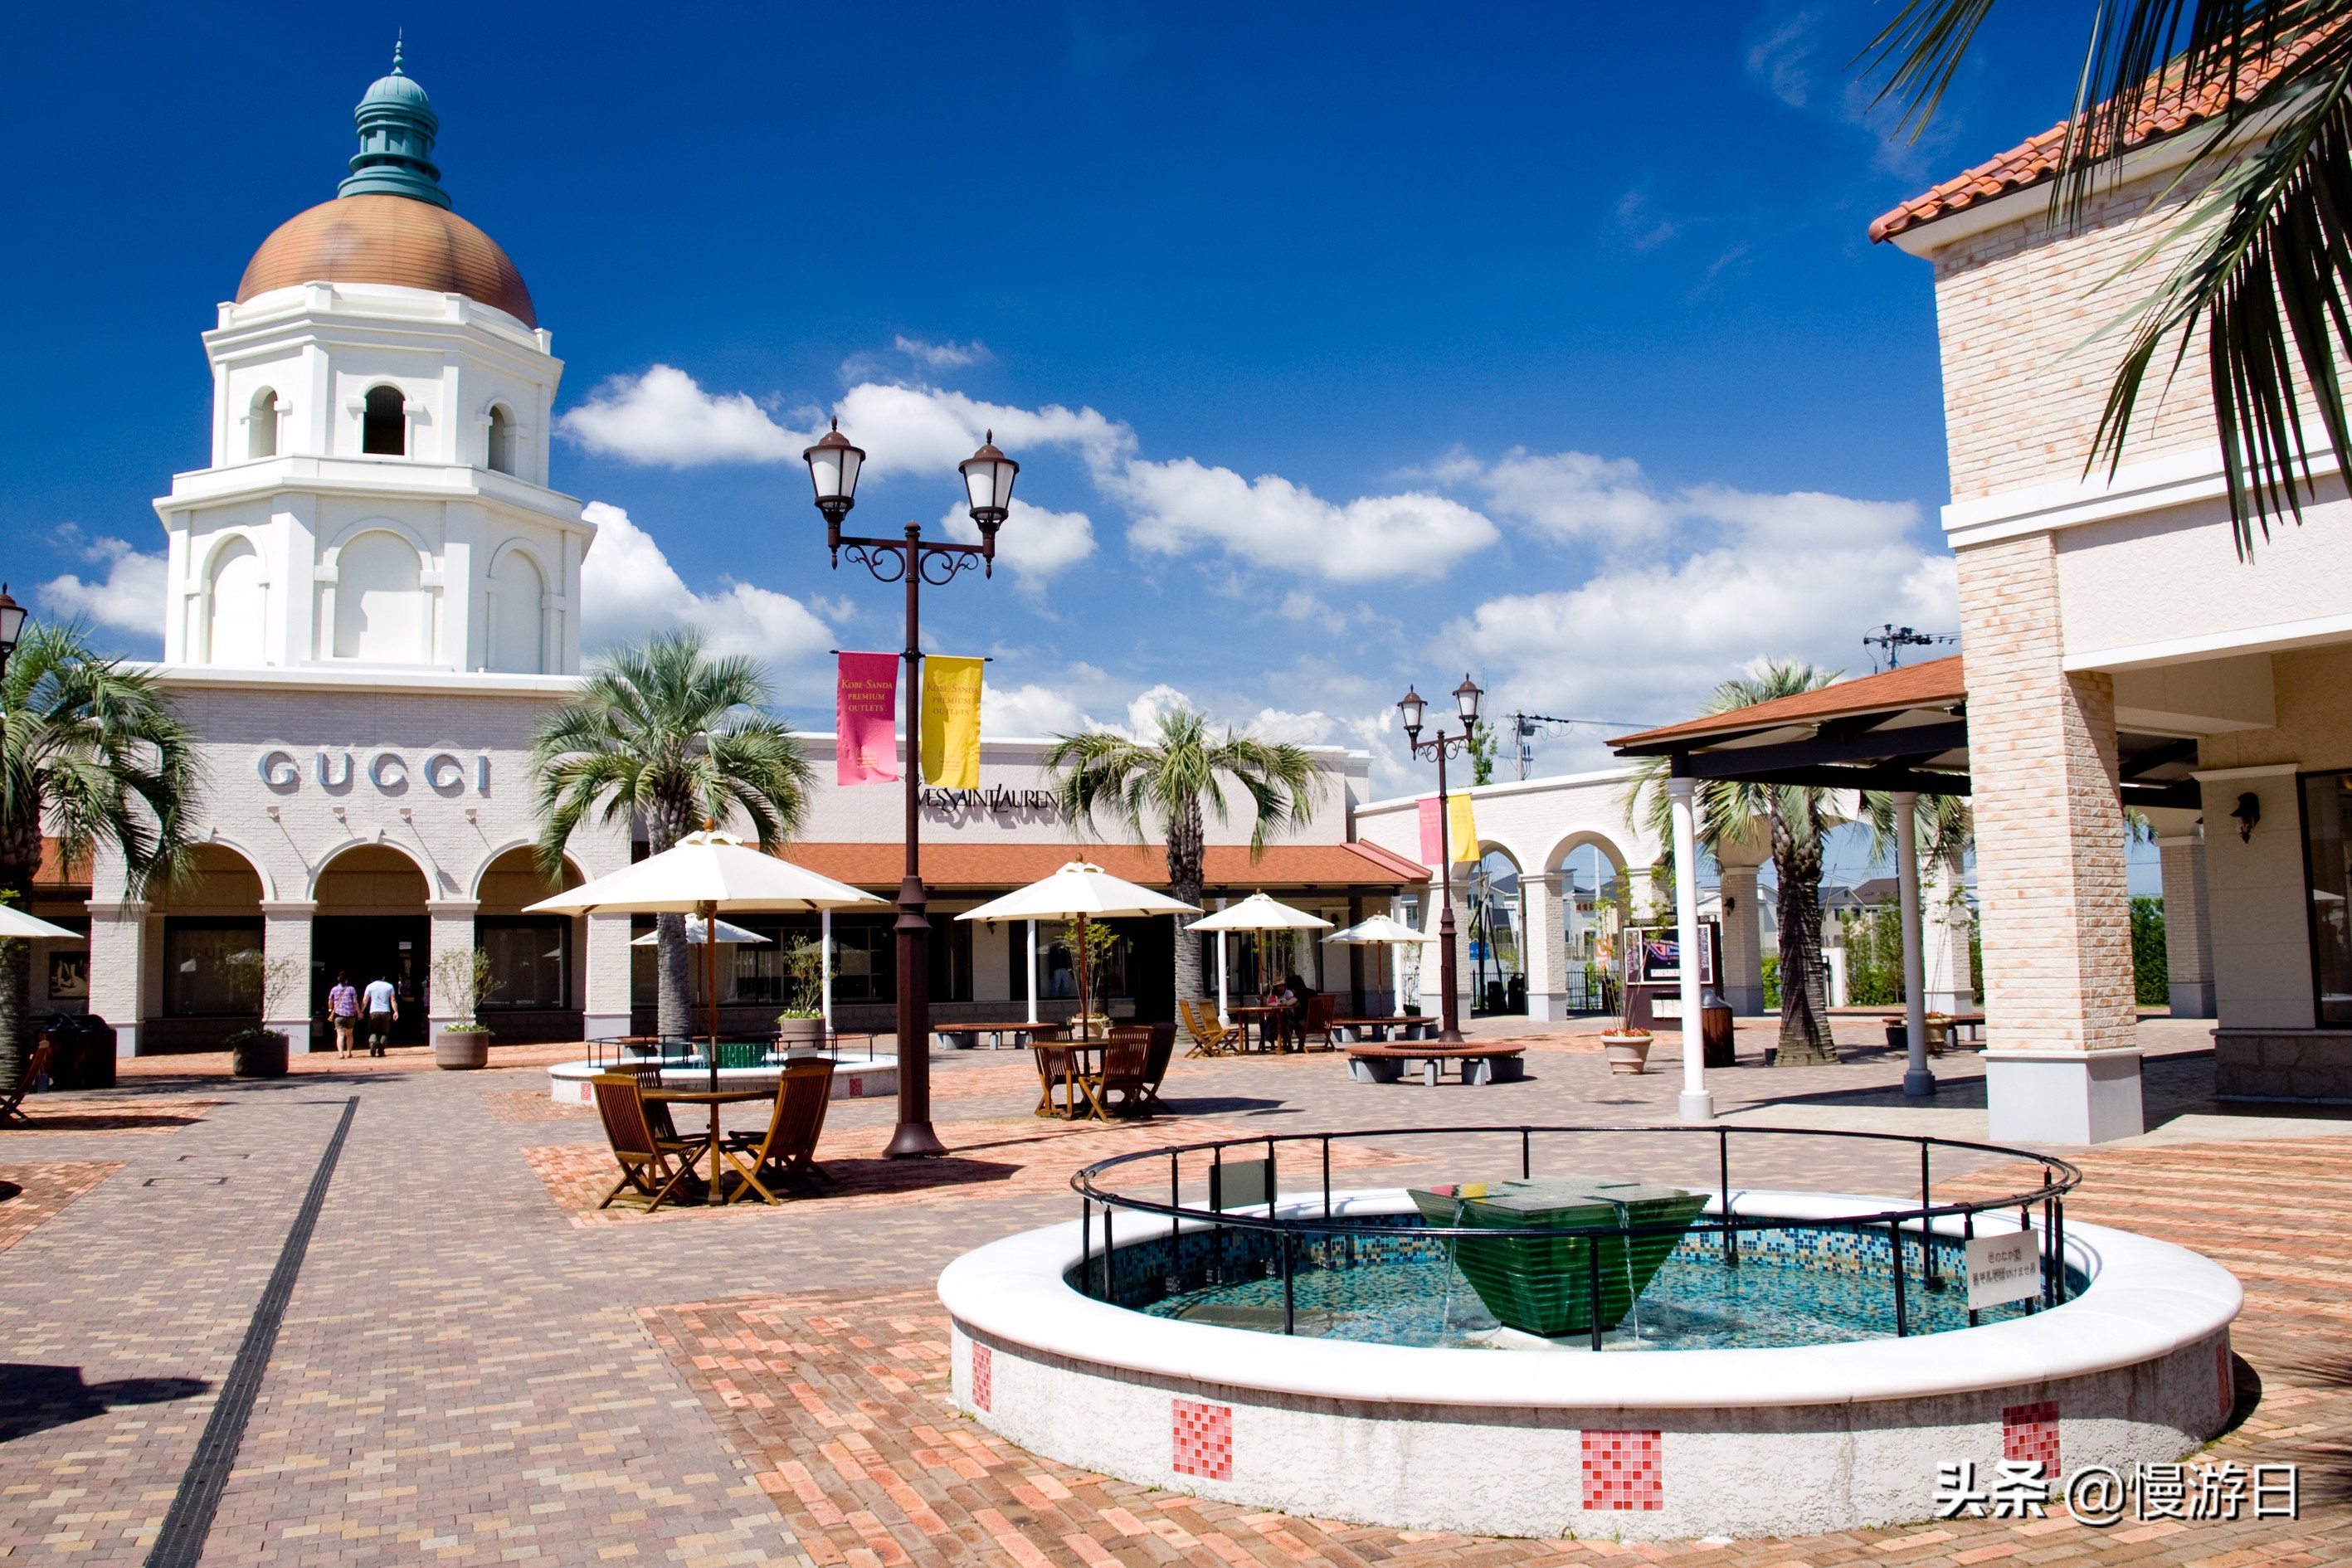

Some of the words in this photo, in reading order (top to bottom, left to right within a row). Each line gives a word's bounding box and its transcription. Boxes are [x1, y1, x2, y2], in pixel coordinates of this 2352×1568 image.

[933, 708, 970, 716] OUTLETS
[258, 750, 486, 788] GUCCI
[918, 782, 947, 807] VES
[993, 783, 1065, 813] LAUREN
